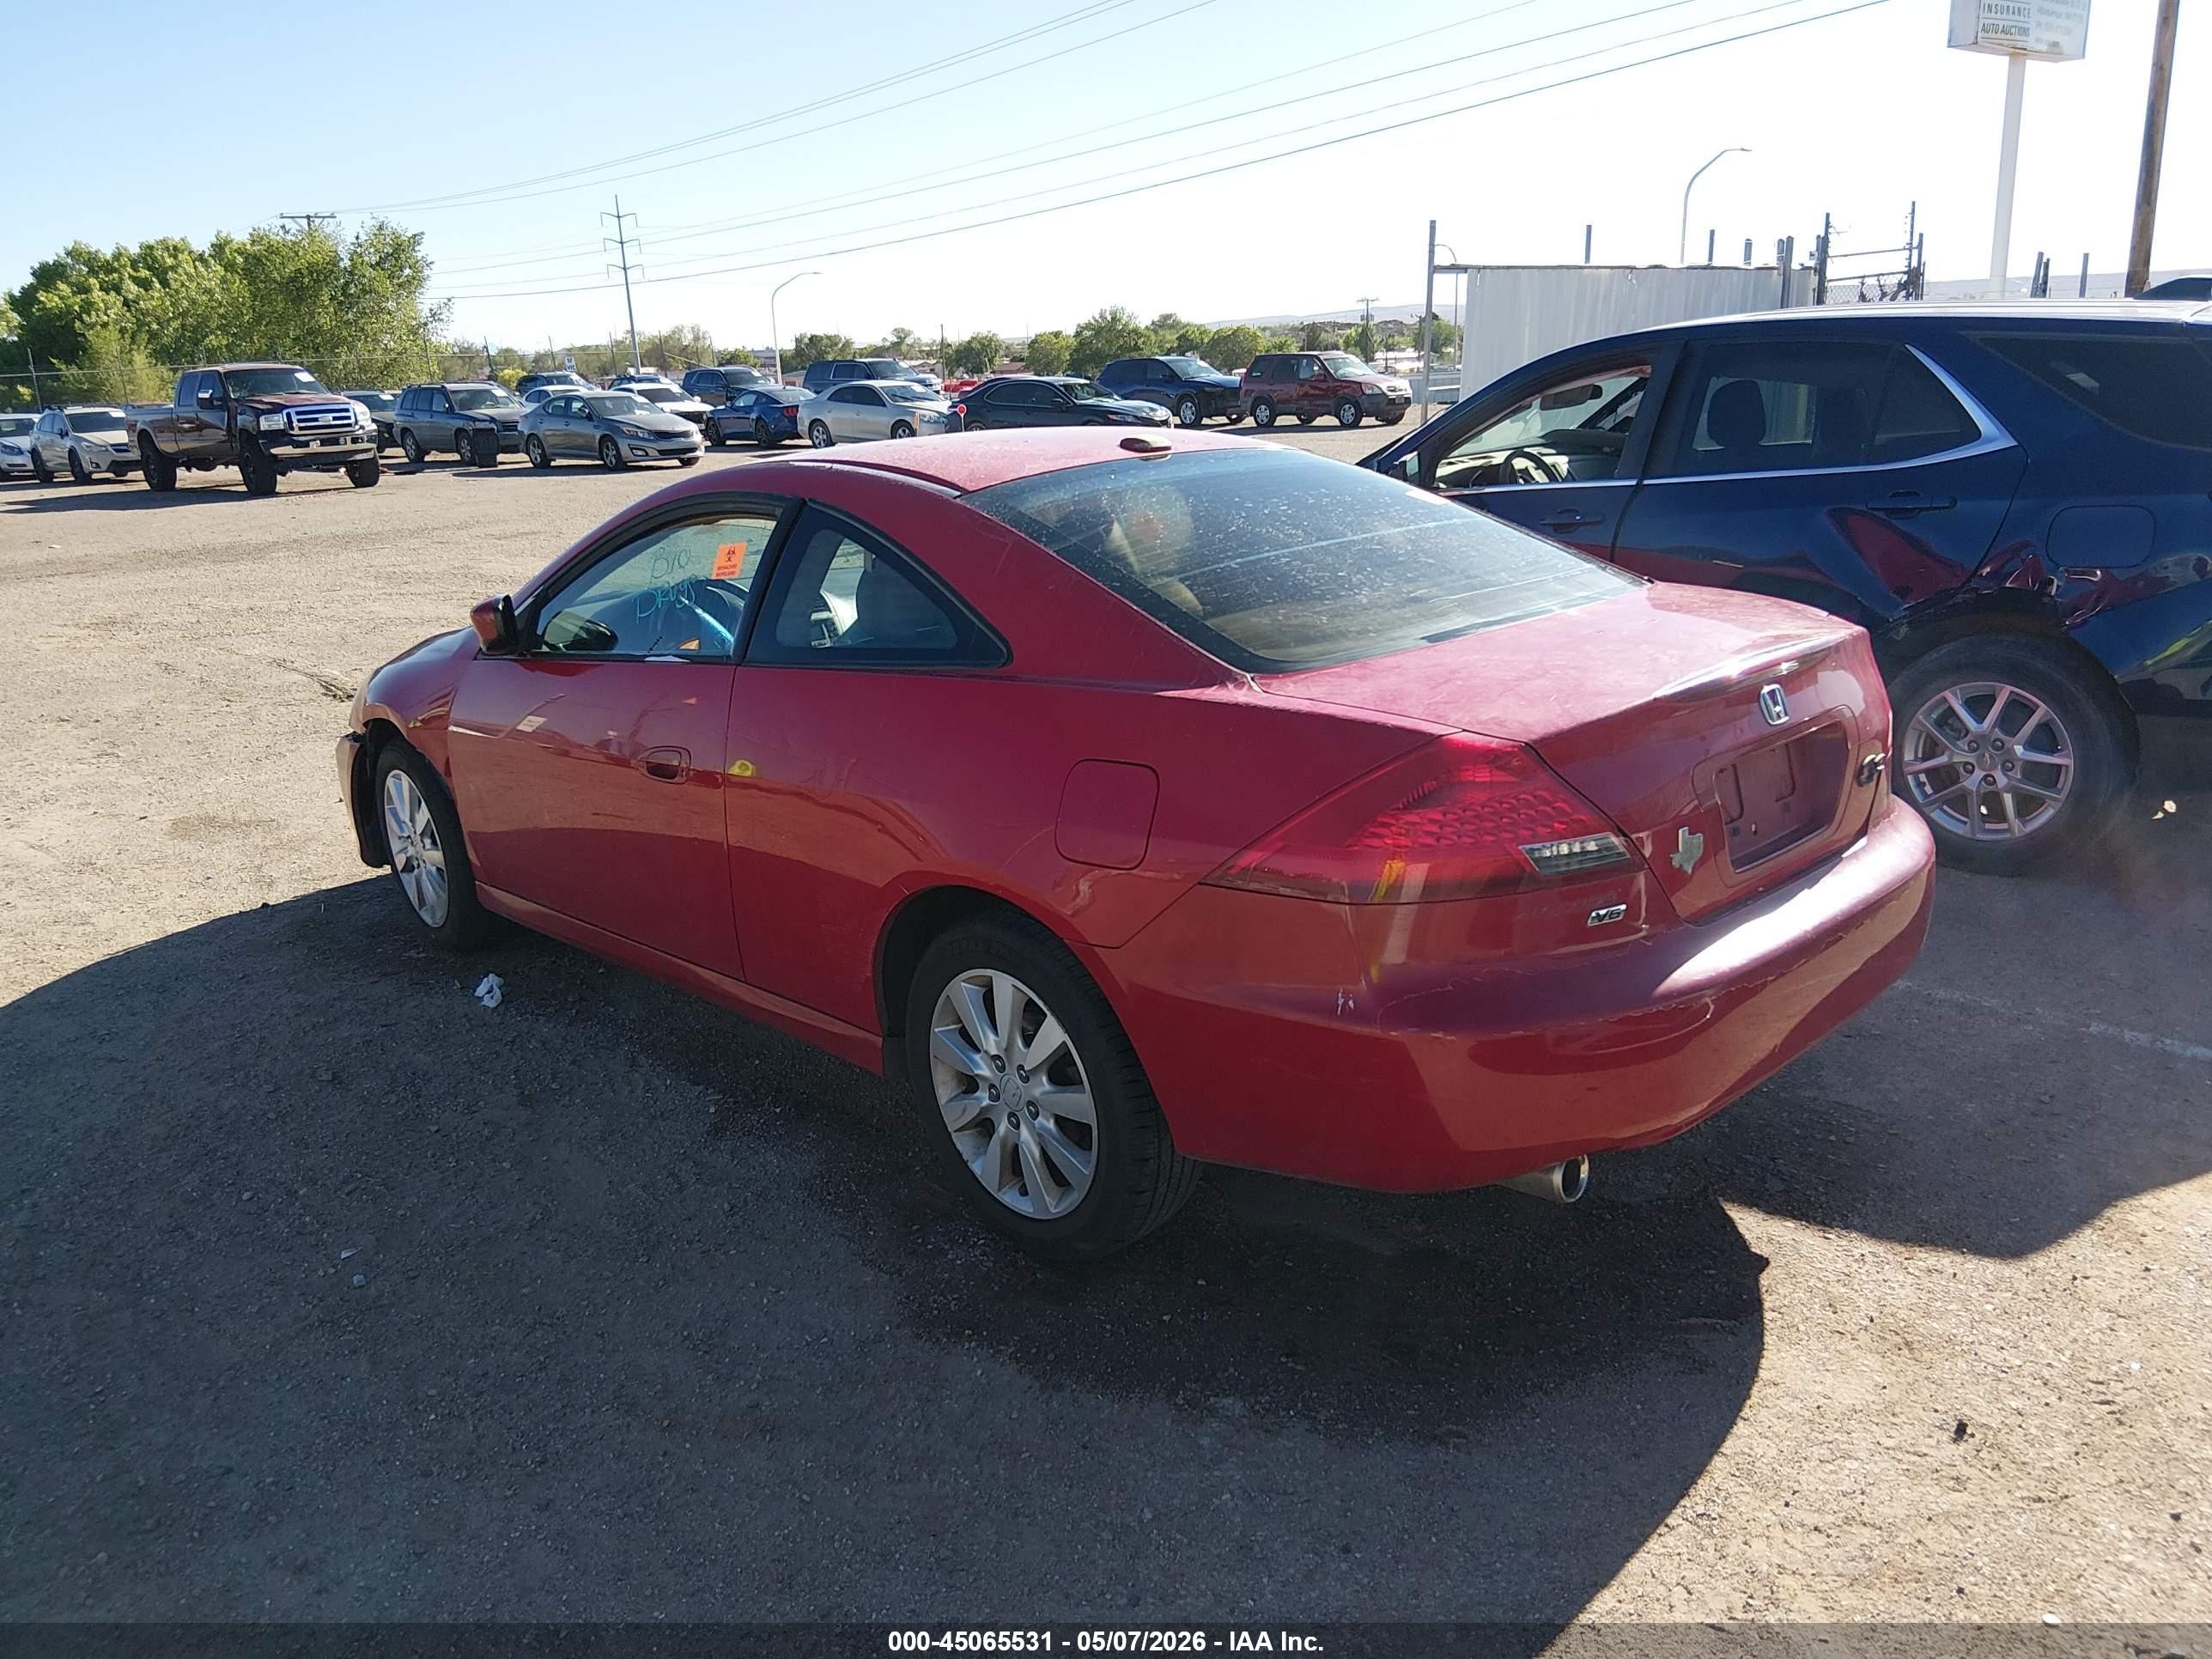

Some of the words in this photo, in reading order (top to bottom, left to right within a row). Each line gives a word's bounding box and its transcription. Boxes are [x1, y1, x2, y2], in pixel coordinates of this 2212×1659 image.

[1983, 3, 2032, 19] INSURANCE
[1981, 22, 2000, 34] AUTO
[2000, 24, 2030, 38] AUCTIONS
